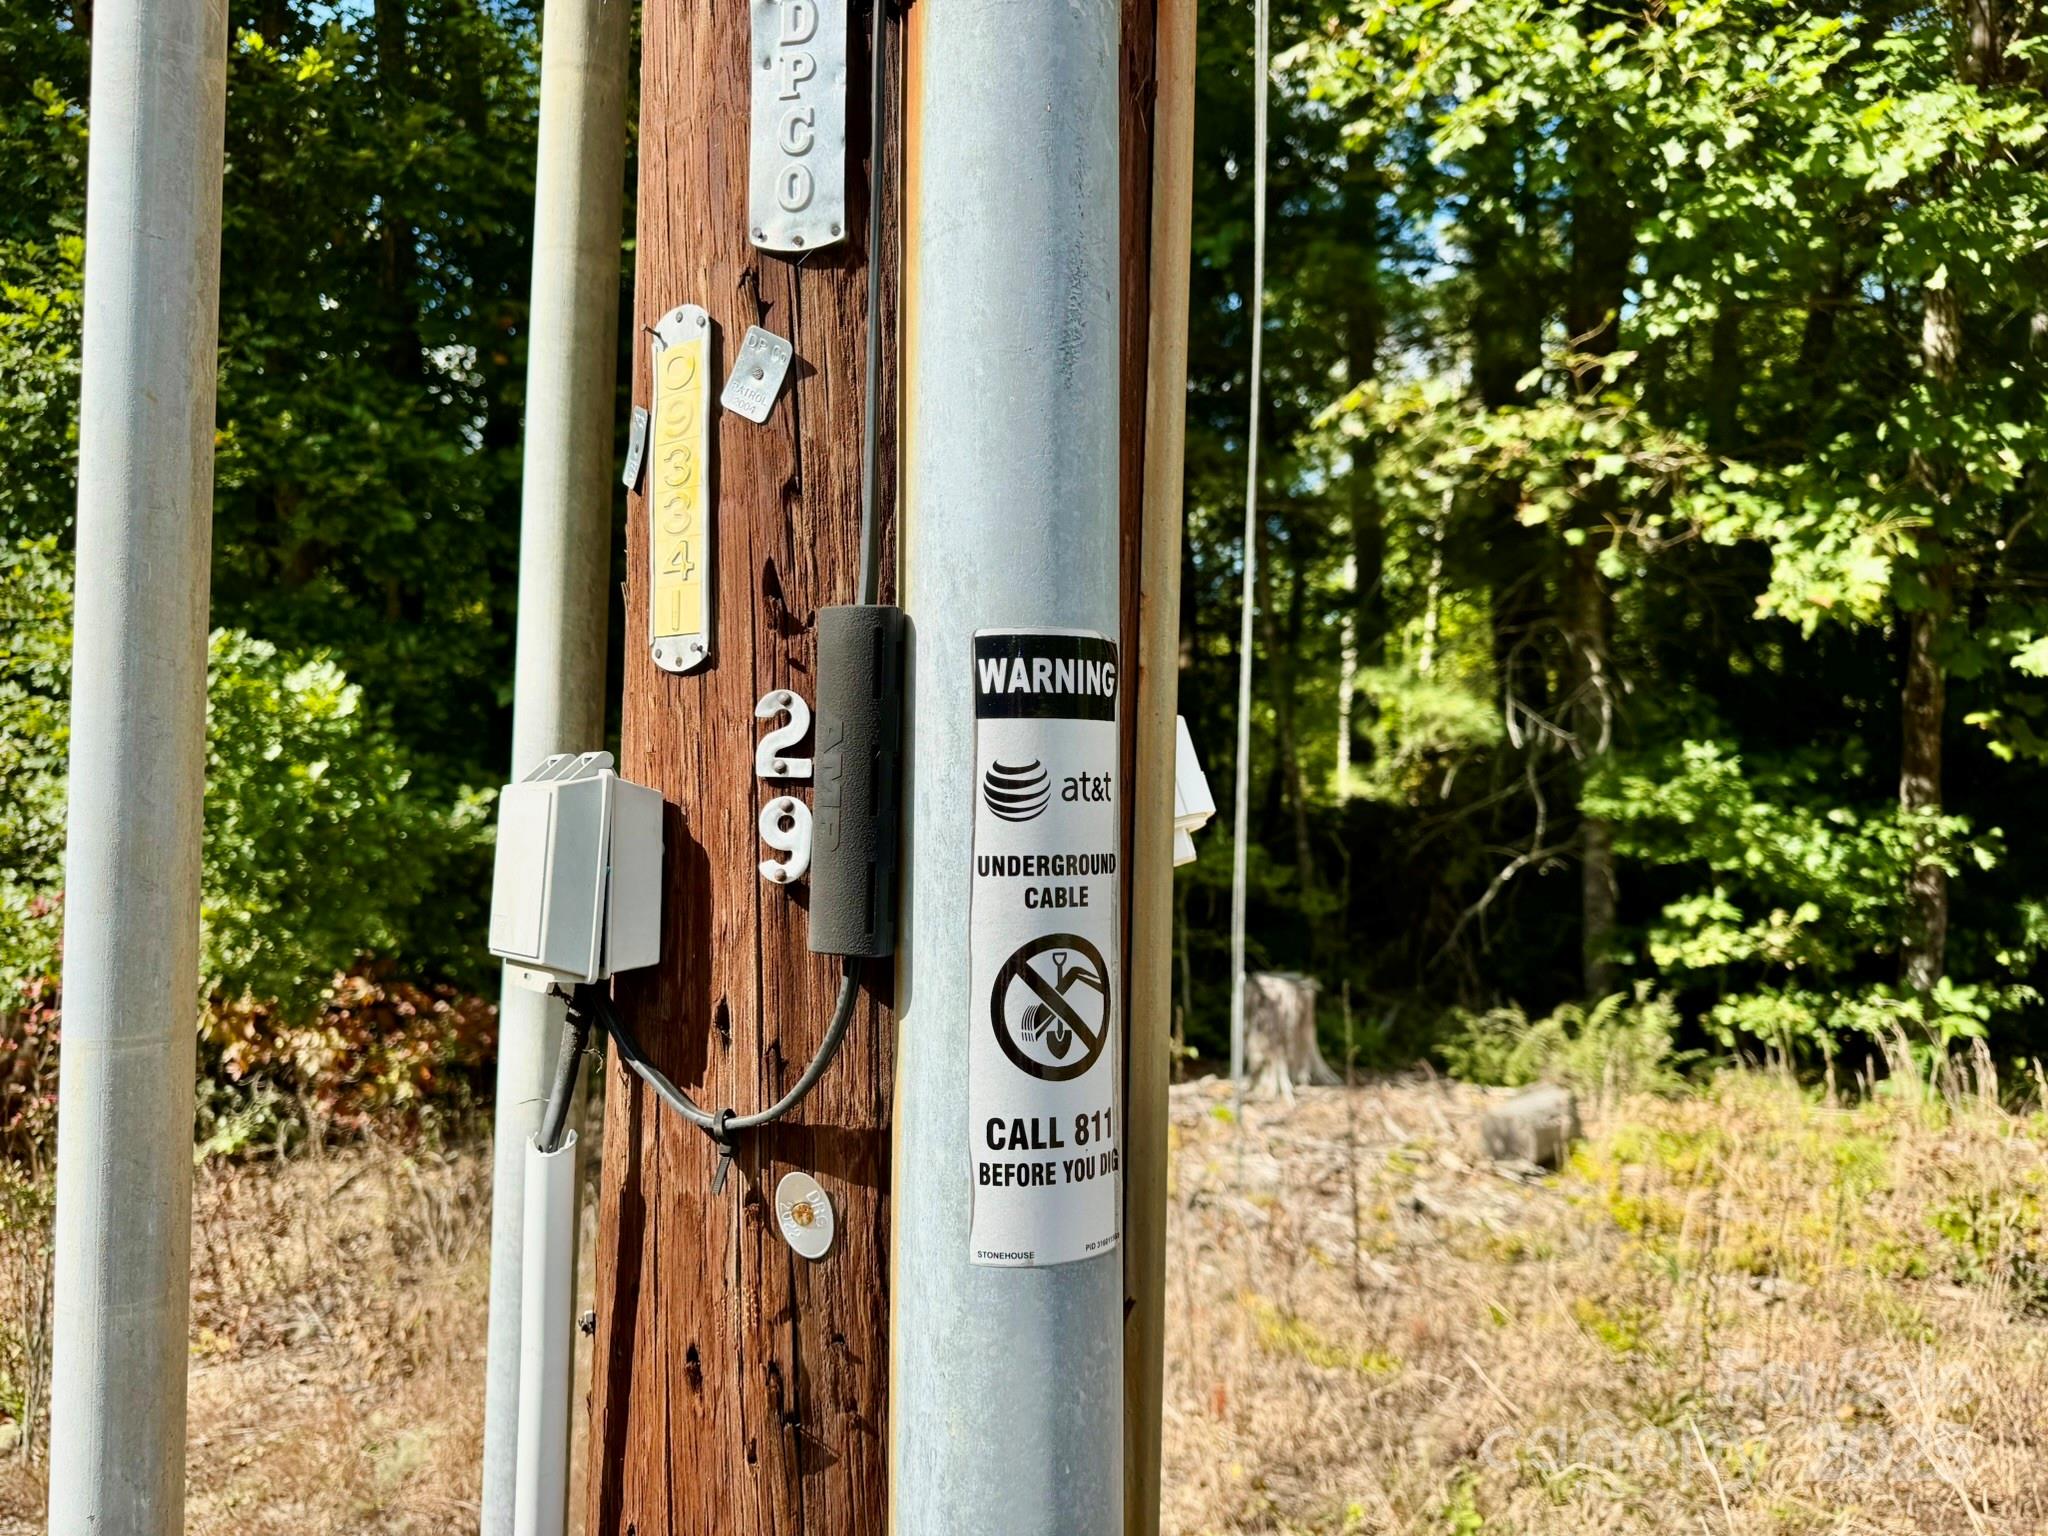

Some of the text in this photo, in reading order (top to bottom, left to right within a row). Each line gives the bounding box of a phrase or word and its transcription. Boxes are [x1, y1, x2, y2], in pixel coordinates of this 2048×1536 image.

[663, 355, 695, 632] 093341
[977, 658, 1117, 698] WARNING
[1060, 771, 1112, 803] at&t
[977, 854, 1117, 877] UNDERGROUND
[1024, 886, 1089, 909] CABLE
[986, 1107, 1112, 1151] CALL 811
[979, 1148, 1120, 1187] BEFORE YOU DIG
[977, 1250, 1035, 1260] STONEHOUSE
[1085, 1242, 1096, 1252] PID
